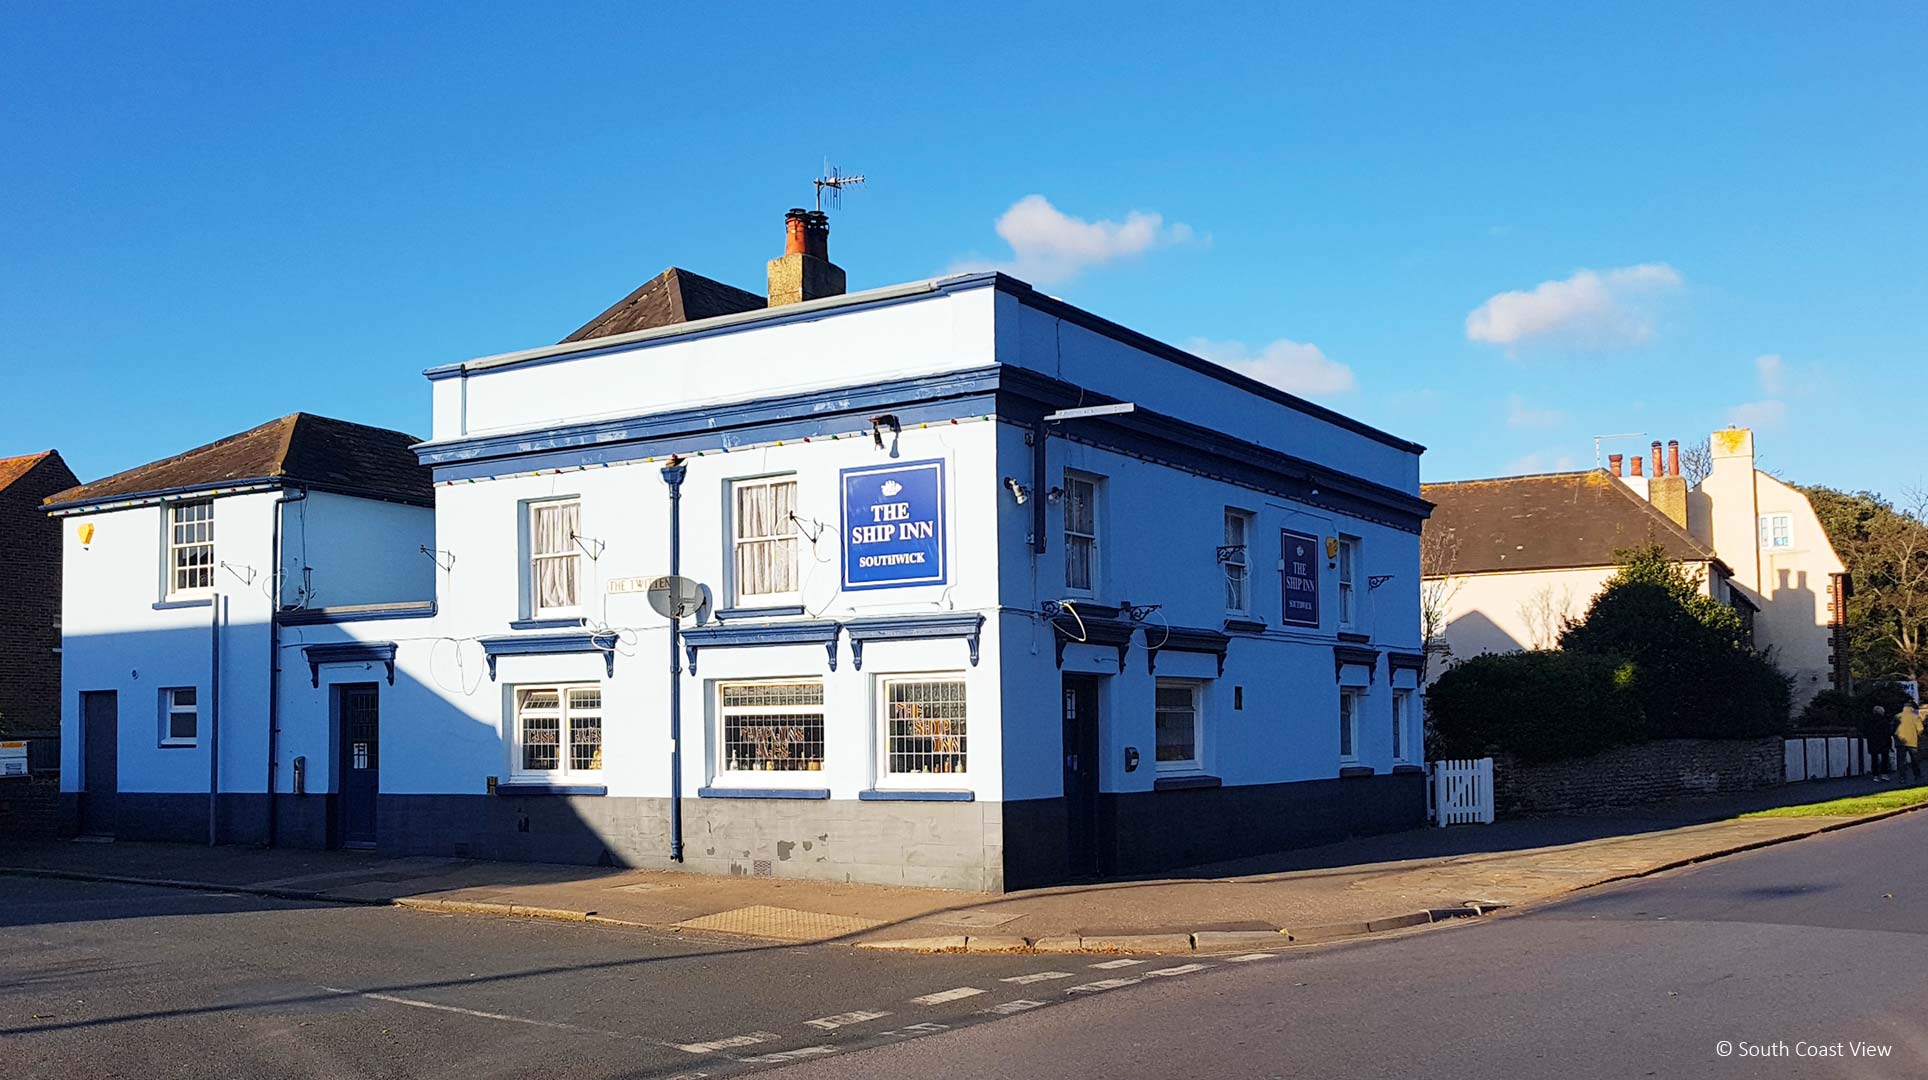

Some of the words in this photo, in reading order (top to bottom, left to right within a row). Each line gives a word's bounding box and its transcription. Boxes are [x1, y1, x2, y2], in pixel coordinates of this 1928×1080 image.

[871, 502, 910, 522] THE
[852, 524, 896, 544] SHIP
[898, 521, 934, 540] INN
[859, 552, 926, 568] SOUTHWICK
[1292, 562, 1307, 576] THE
[609, 580, 625, 592] THE
[1286, 576, 1302, 590] SHIP
[1303, 579, 1315, 593] INN
[896, 703, 923, 719] THE
[914, 719, 951, 736] SHIP
[932, 736, 960, 753] INN
